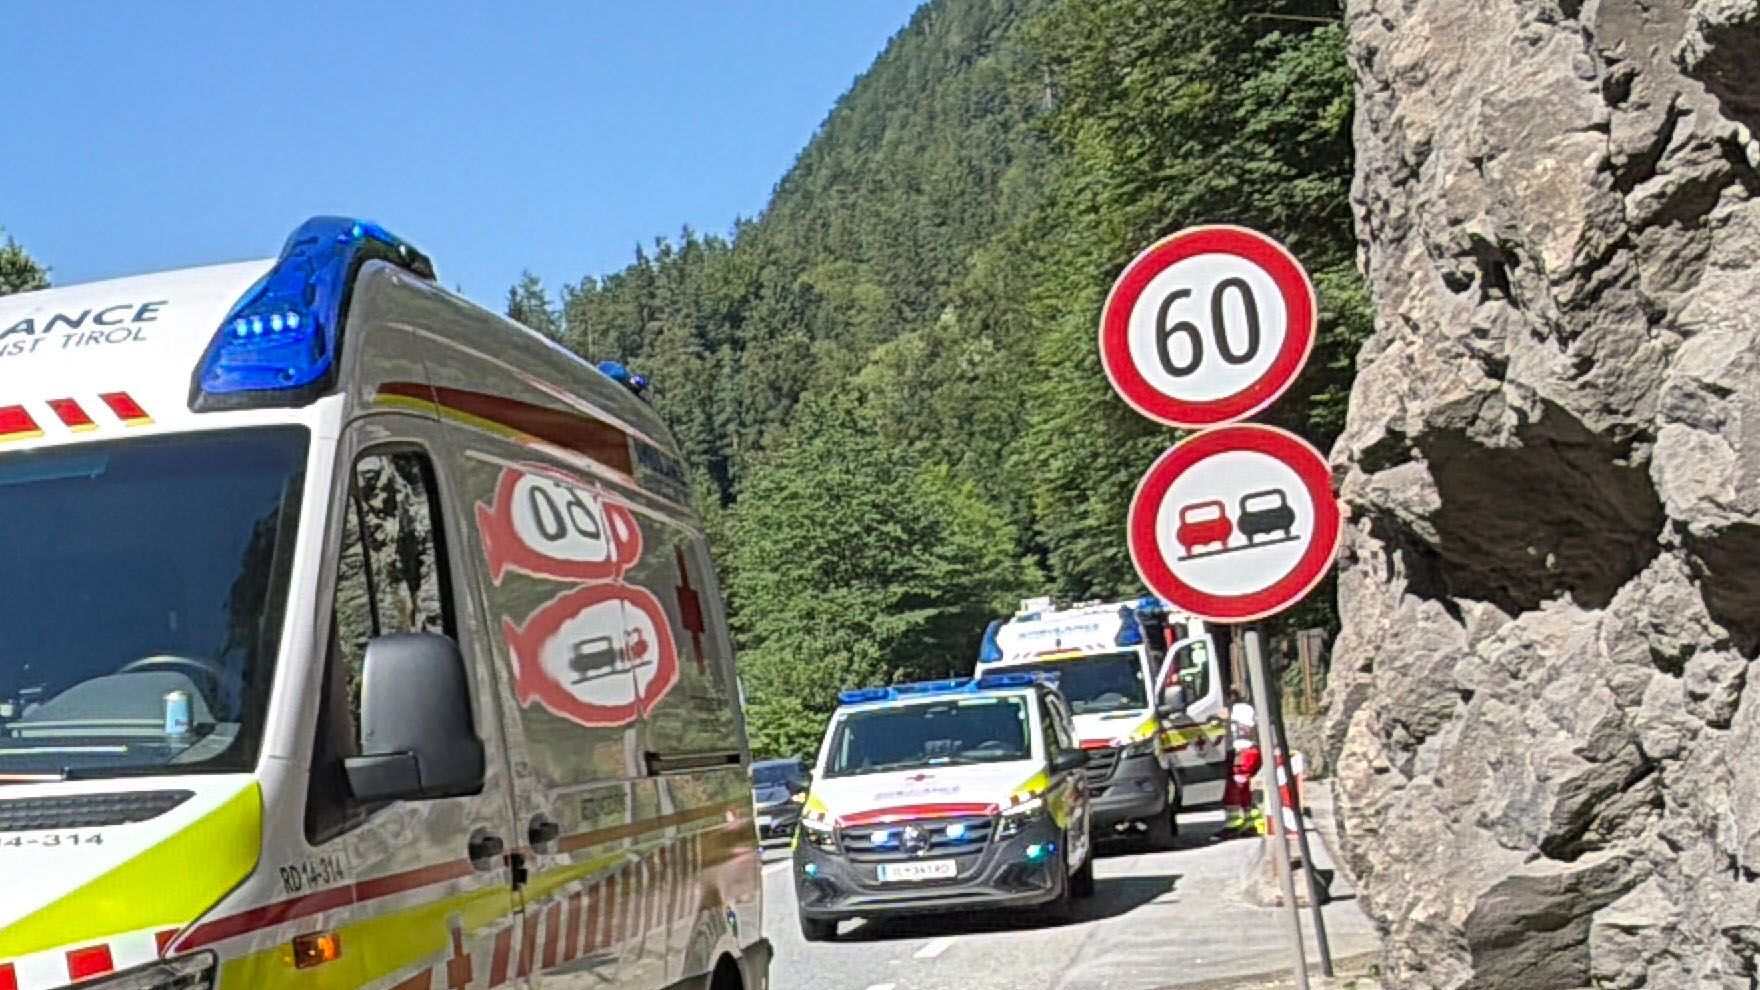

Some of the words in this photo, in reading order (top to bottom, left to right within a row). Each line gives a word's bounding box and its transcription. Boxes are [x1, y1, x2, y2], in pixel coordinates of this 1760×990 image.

[61, 326, 148, 350] TIROL
[1155, 276, 1261, 378] 60
[279, 865, 302, 893] RD
